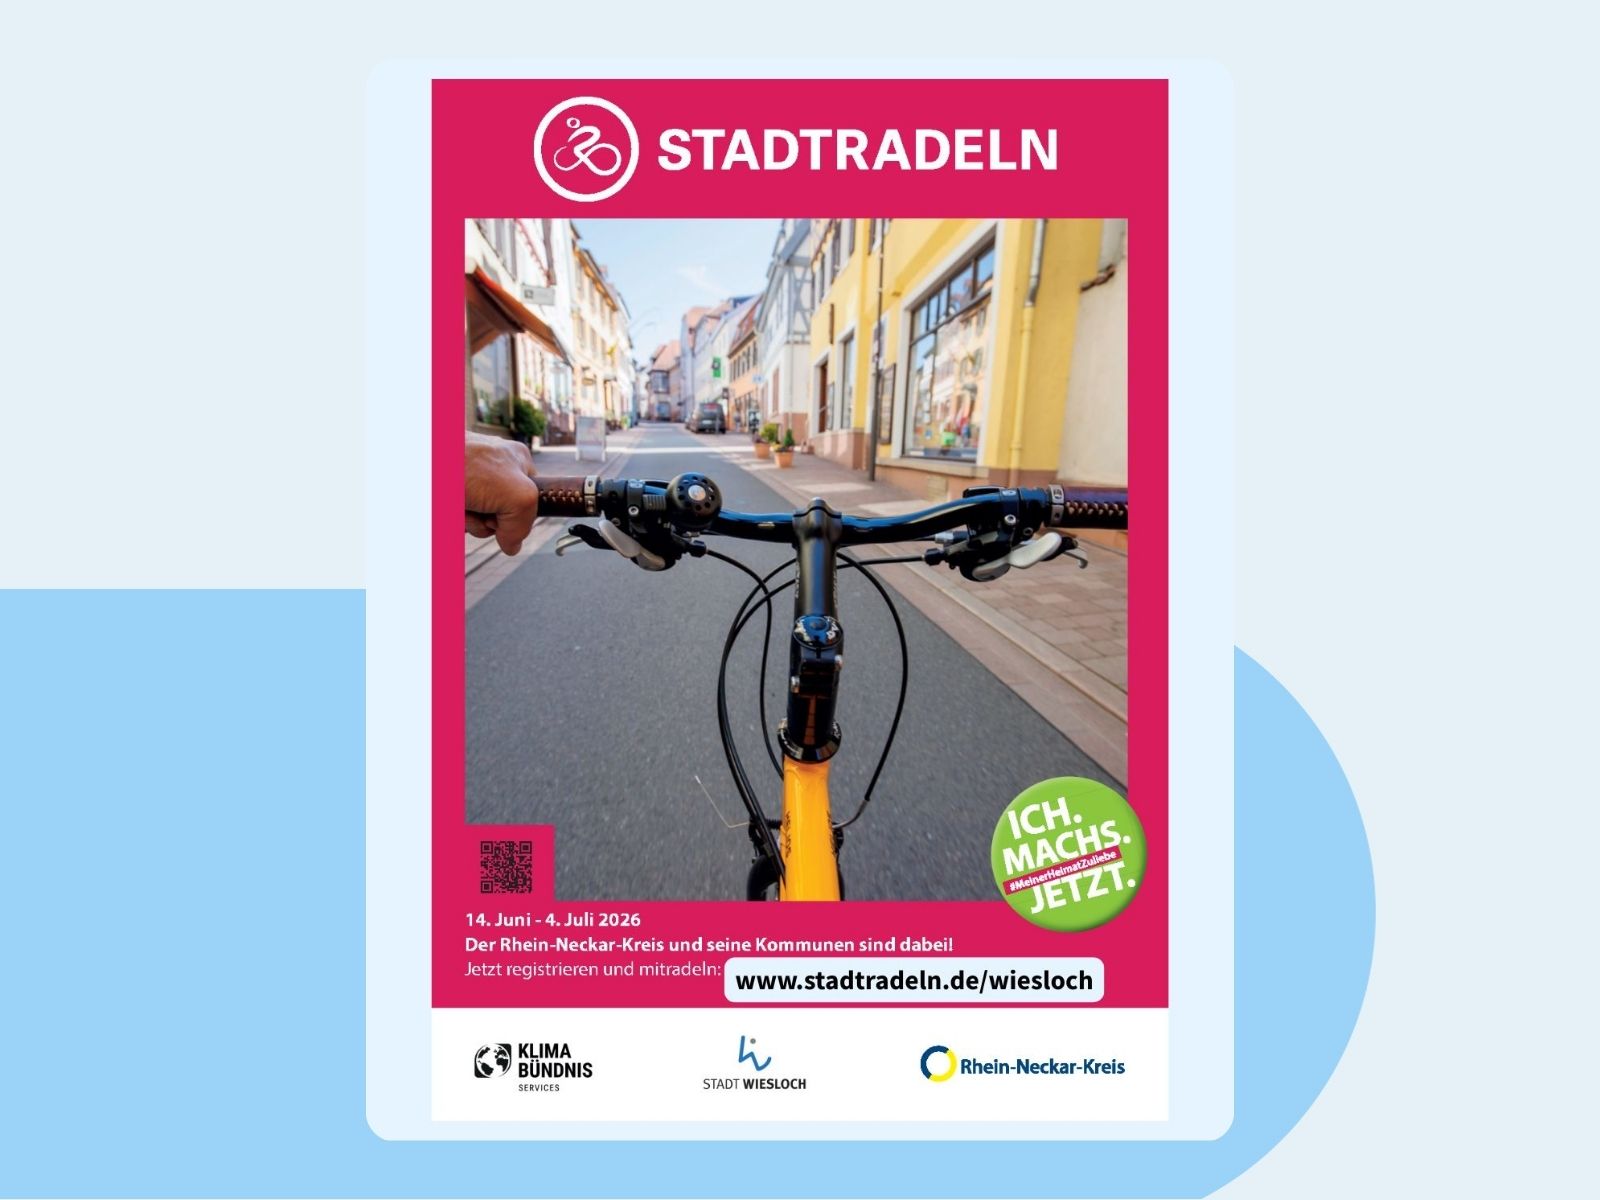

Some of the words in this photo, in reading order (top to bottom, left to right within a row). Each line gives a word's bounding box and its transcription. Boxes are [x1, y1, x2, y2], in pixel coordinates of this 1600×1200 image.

[657, 128, 1058, 171] STADTRADELN
[1007, 797, 1082, 840] ICH.
[1002, 820, 1131, 875] MACHS.
[1009, 850, 1117, 892] #MeinerHeimatZuliebe
[1030, 861, 1136, 914] JETZT.
[466, 912, 491, 927] 14.
[494, 912, 531, 927] Juni
[545, 912, 561, 927] 4.
[564, 912, 594, 927] Juli
[598, 912, 641, 927] 2026
[465, 937, 497, 952] Der
[500, 936, 665, 952] Rhein-Neckar-Kreis
[669, 936, 703, 952] und
[706, 937, 752, 952] seine
[755, 937, 855, 952] Kommunen
[859, 936, 896, 952] sind
[899, 936, 954, 952] dabei!
[464, 961, 503, 976] Jetzt
[506, 961, 598, 980] registrieren
[603, 961, 634, 976] und
[639, 961, 721, 976] mitradeln:
[735, 969, 1093, 994] www.stadtradeln.de/wiesloch
[518, 1043, 572, 1059] KLIMA
[518, 1060, 593, 1079] BÜNDNIS
[960, 1058, 1126, 1075] Rhein-Neckar-Kreis
[518, 1084, 560, 1092] SERVICES
[703, 1078, 740, 1090] STADT
[743, 1078, 807, 1090] WIESLOCH
